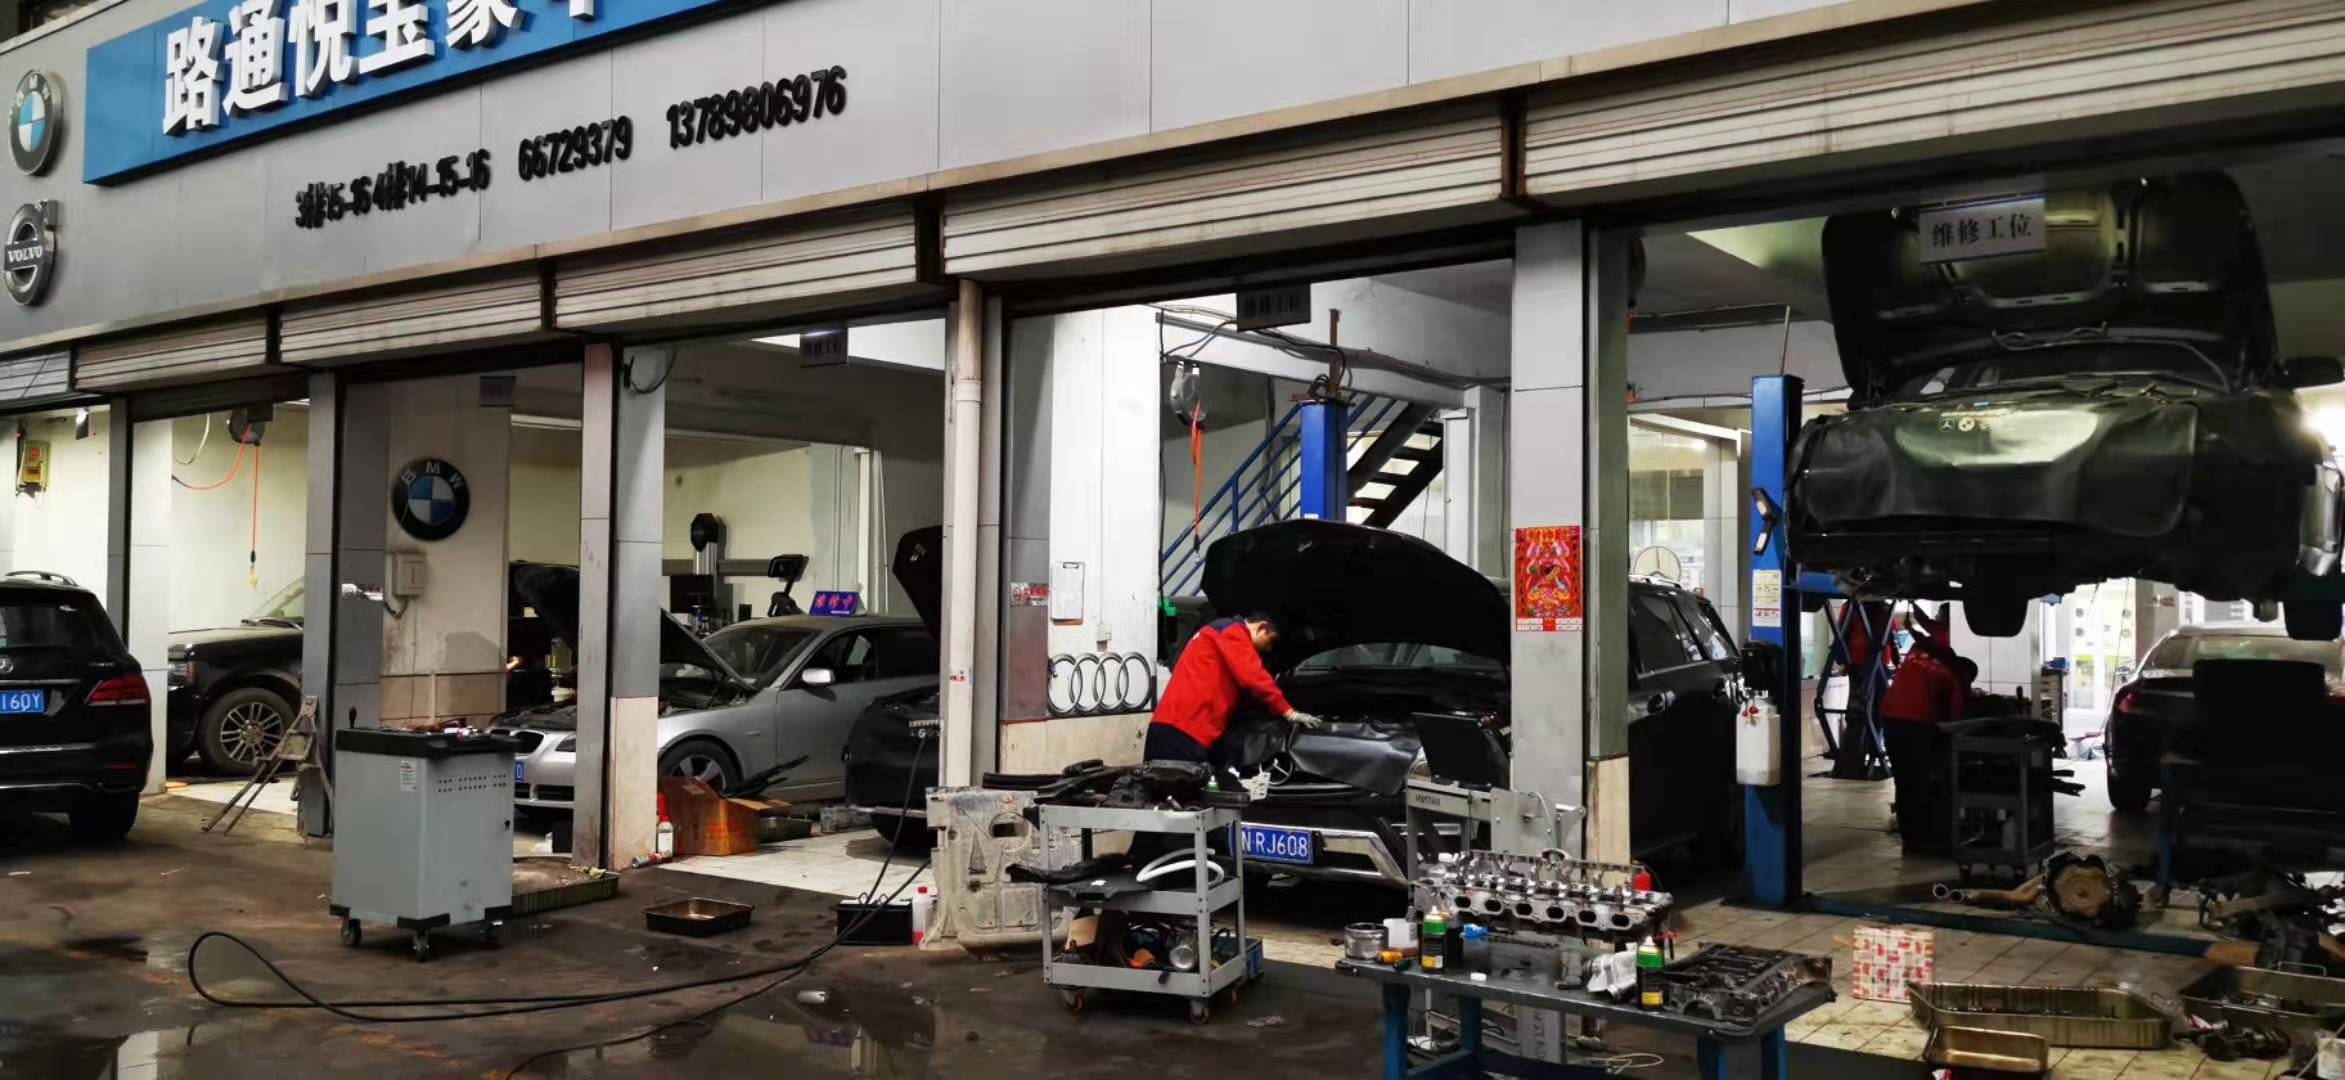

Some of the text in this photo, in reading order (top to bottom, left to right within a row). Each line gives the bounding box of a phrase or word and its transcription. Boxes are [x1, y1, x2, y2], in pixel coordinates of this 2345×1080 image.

[518, 115, 633, 181] 66729379
[666, 65, 847, 149] 13789806976
[1932, 213, 2032, 247] 维修工位
[8, 247, 43, 272] VOLVO
[401, 461, 464, 489] BMW
